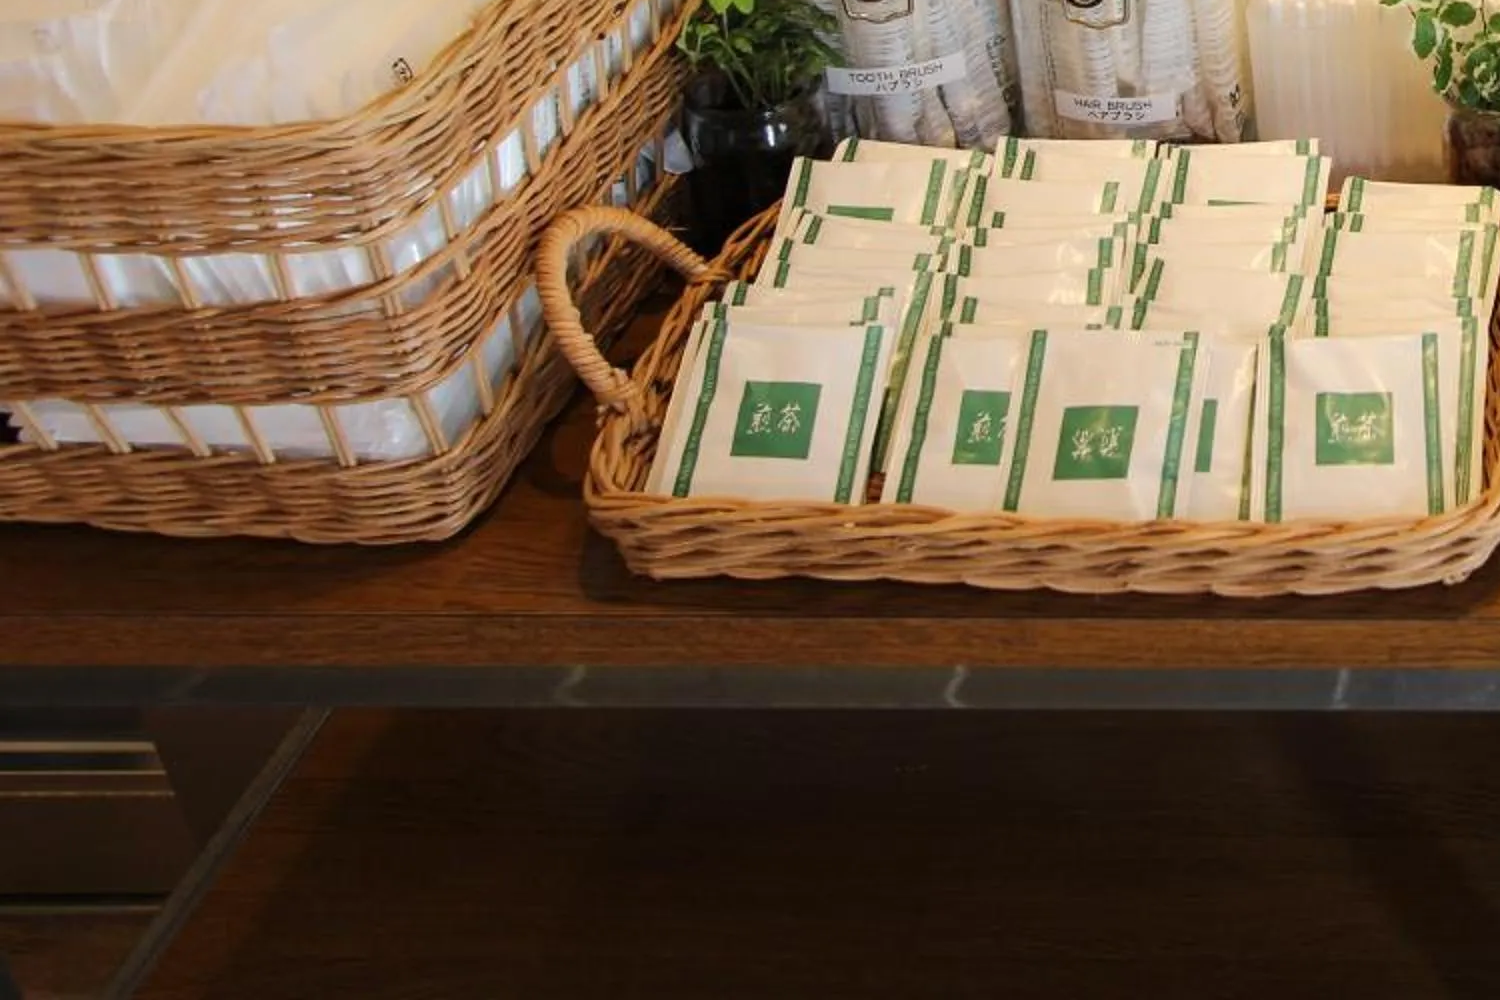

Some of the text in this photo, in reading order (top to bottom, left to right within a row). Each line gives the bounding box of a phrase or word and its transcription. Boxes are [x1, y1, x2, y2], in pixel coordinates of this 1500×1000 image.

[848, 62, 943, 84] TOOTH BRUSH
[1074, 98, 1152, 111] HAIR BRUSH
[745, 401, 801, 436] 煎茶
